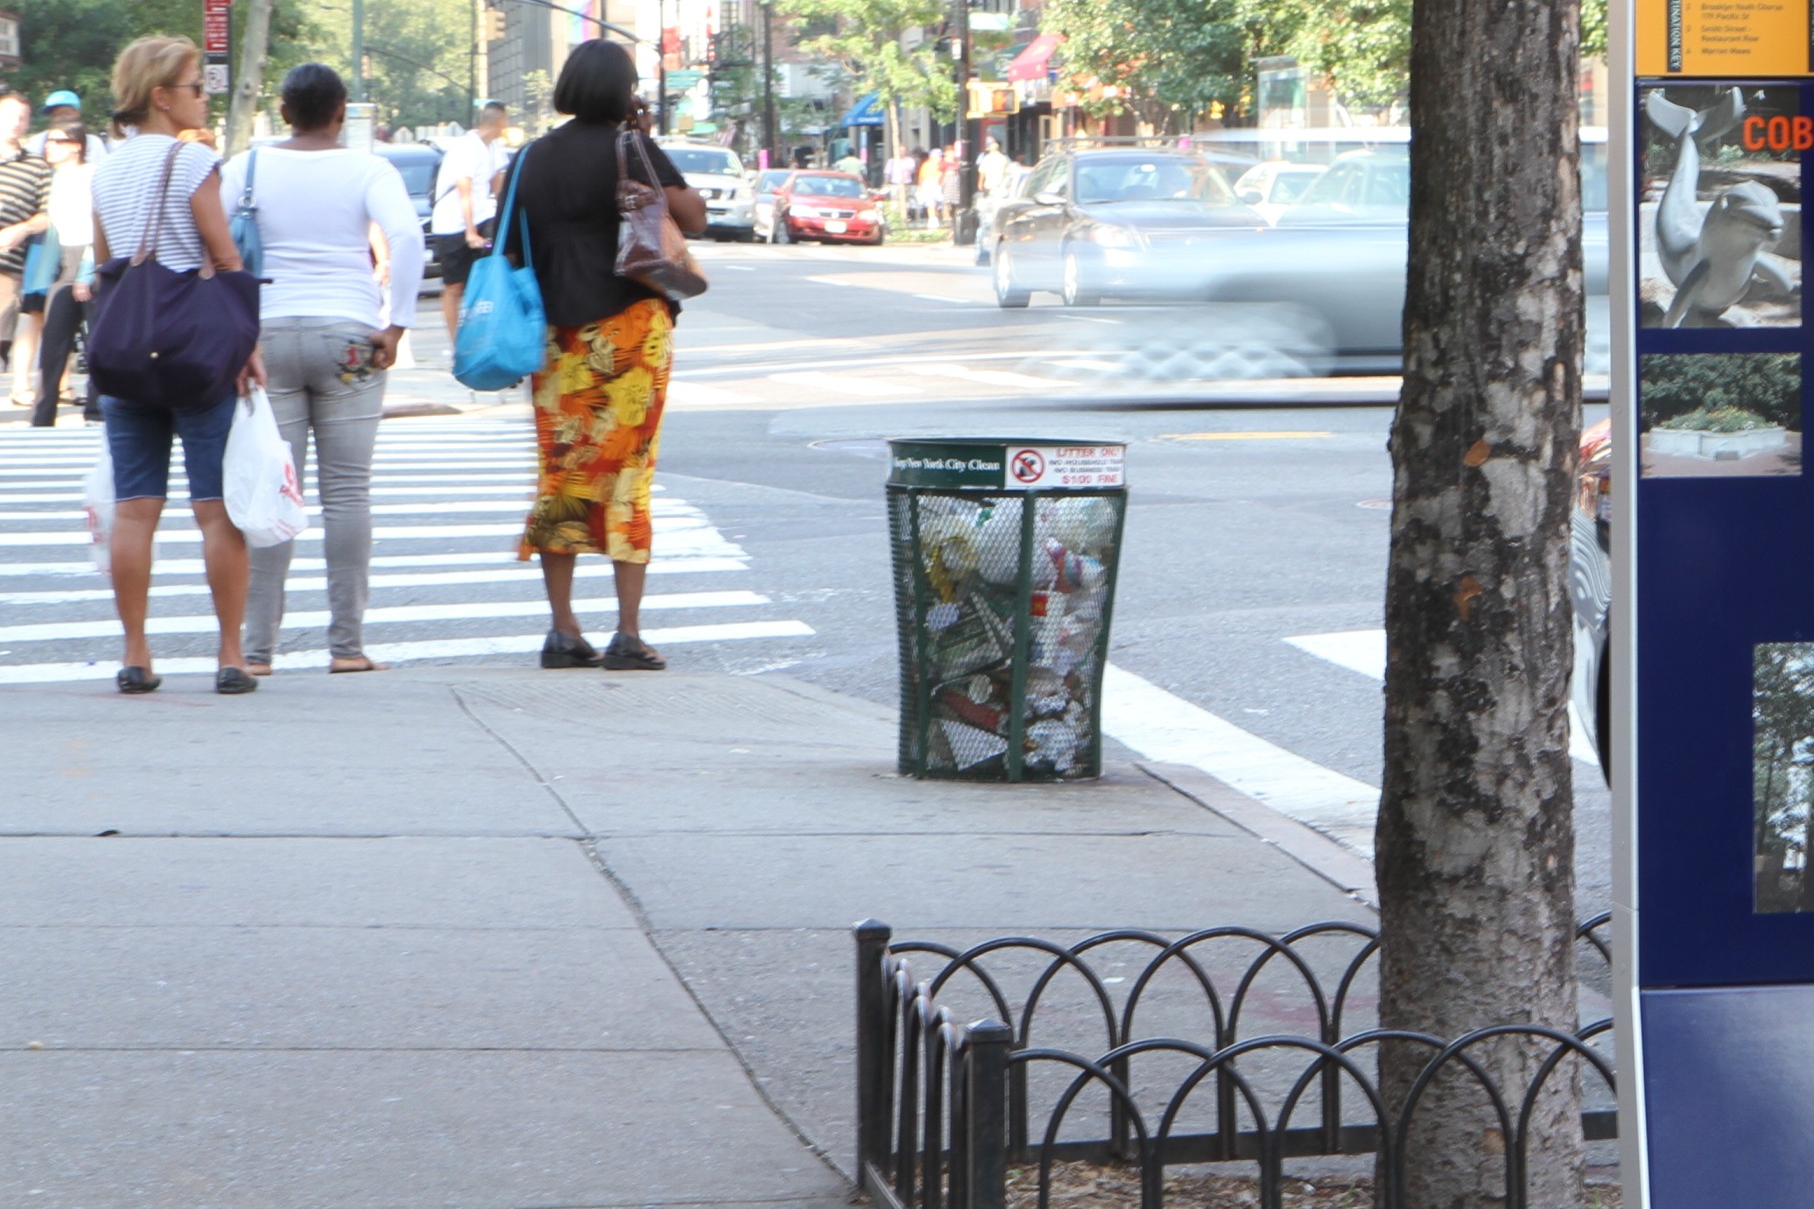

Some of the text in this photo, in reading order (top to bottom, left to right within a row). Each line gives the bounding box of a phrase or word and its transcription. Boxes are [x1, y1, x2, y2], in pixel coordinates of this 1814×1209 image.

[1670, 48, 1681, 69] KEY
[1056, 448, 1097, 457] LITTER
[924, 458, 945, 470] York
[945, 458, 968, 473] City
[968, 459, 1000, 471] Clean
[1061, 474, 1118, 485] $100 FINE
